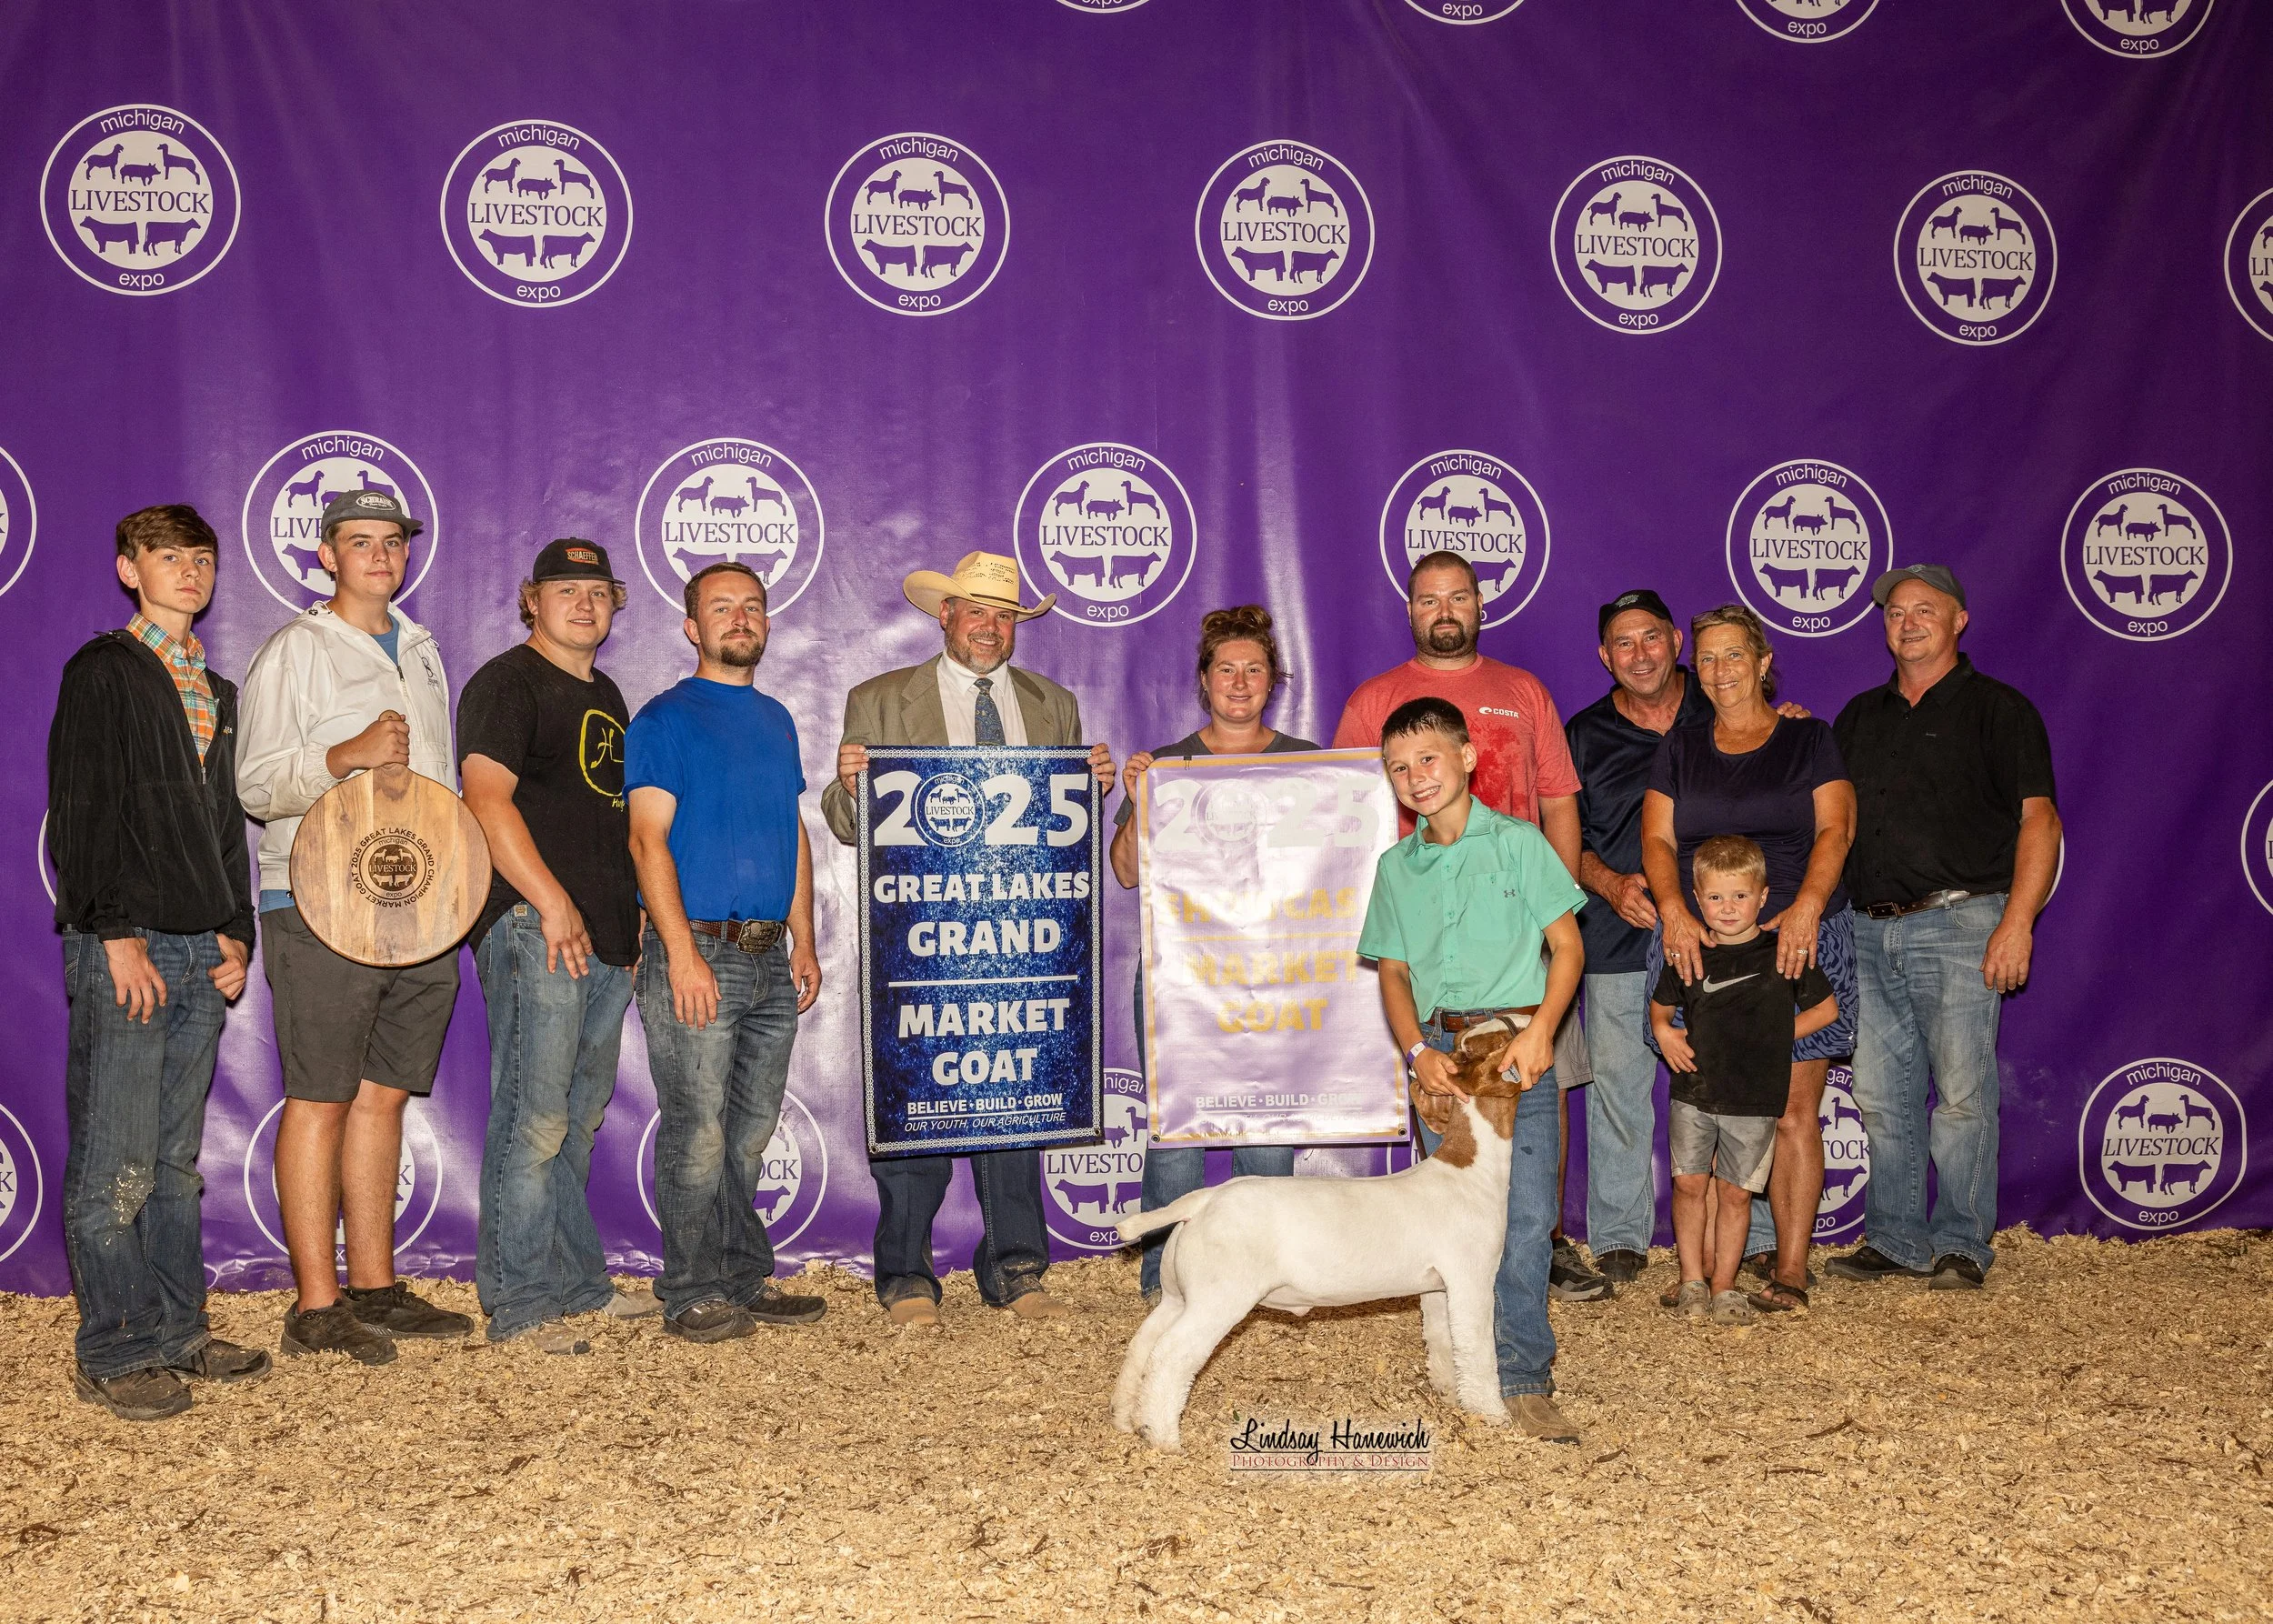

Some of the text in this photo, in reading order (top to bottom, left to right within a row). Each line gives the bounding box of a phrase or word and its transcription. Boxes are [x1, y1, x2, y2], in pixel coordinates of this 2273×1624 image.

[1443, 4, 1482, 19] expo
[1788, 22, 1826, 38] expo
[2121, 39, 2158, 54] expo
[101, 110, 184, 134] michigan
[498, 125, 579, 150] michigan
[880, 137, 957, 161] michigan
[1248, 145, 1323, 170] michigan
[1601, 161, 1674, 185] michigan
[1943, 175, 2012, 198] michigan
[72, 190, 209, 214] LIVESTOCK
[471, 203, 603, 226] LIVESTOCK
[854, 215, 981, 236] LIVESTOCK
[1224, 222, 1347, 244] LIVESTOCK
[1577, 235, 1695, 257] LIVESTOCK
[1920, 248, 2032, 270] LIVESTOCK
[119, 274, 164, 290] expo
[517, 286, 560, 302] expo
[899, 295, 940, 311] expo
[1268, 300, 1308, 315] expo
[1619, 314, 1658, 329] expo
[1959, 325, 1997, 340] expo
[302, 436, 384, 460] michigan
[692, 444, 771, 466] michigan
[1067, 448, 1145, 471] michigan
[1430, 455, 1501, 479] michigan
[1776, 465, 1847, 487] michigan
[2108, 473, 2180, 495] michigan
[665, 522, 795, 543] LIVESTOCK
[1042, 526, 1168, 546] LIVESTOCK
[1407, 529, 1523, 553] LIVESTOCK
[1753, 538, 1867, 560] LIVESTOCK
[2086, 546, 2205, 565] LIVESTOCK
[1087, 606, 1128, 621] expo
[1793, 617, 1830, 632] expo
[2128, 621, 2168, 637] expo
[1493, 708, 1519, 718] COSTA
[926, 806, 975, 816] LIVESTOCK
[379, 837, 408, 846] michigan
[351, 827, 435, 907] 2025 GREAT LAKES GRAND CHAMPION MARKET GOAT
[369, 864, 416, 873] LIVESTOCK
[874, 872, 1090, 904] GREAT LAKES
[908, 918, 1061, 957] GRAND
[898, 998, 1070, 1038] MARKET
[1217, 998, 1328, 1034] GOAT
[932, 1048, 1037, 1086] GOAT
[2127, 1063, 2200, 1085] michigan
[907, 1093, 1063, 1115] BELIEVE BUILD GROW
[1196, 1094, 1257, 1108] BELIEVE
[1265, 1093, 1309, 1107] BUILD
[904, 1112, 1066, 1132] OUR YOUTH, OUR AGRICULTURE
[2103, 1138, 2219, 1156] LIVESTOCK
[1046, 1152, 1144, 1174] LIVESTO
[2139, 1211, 2178, 1225] expo
[1090, 1230, 1118, 1245] exp
